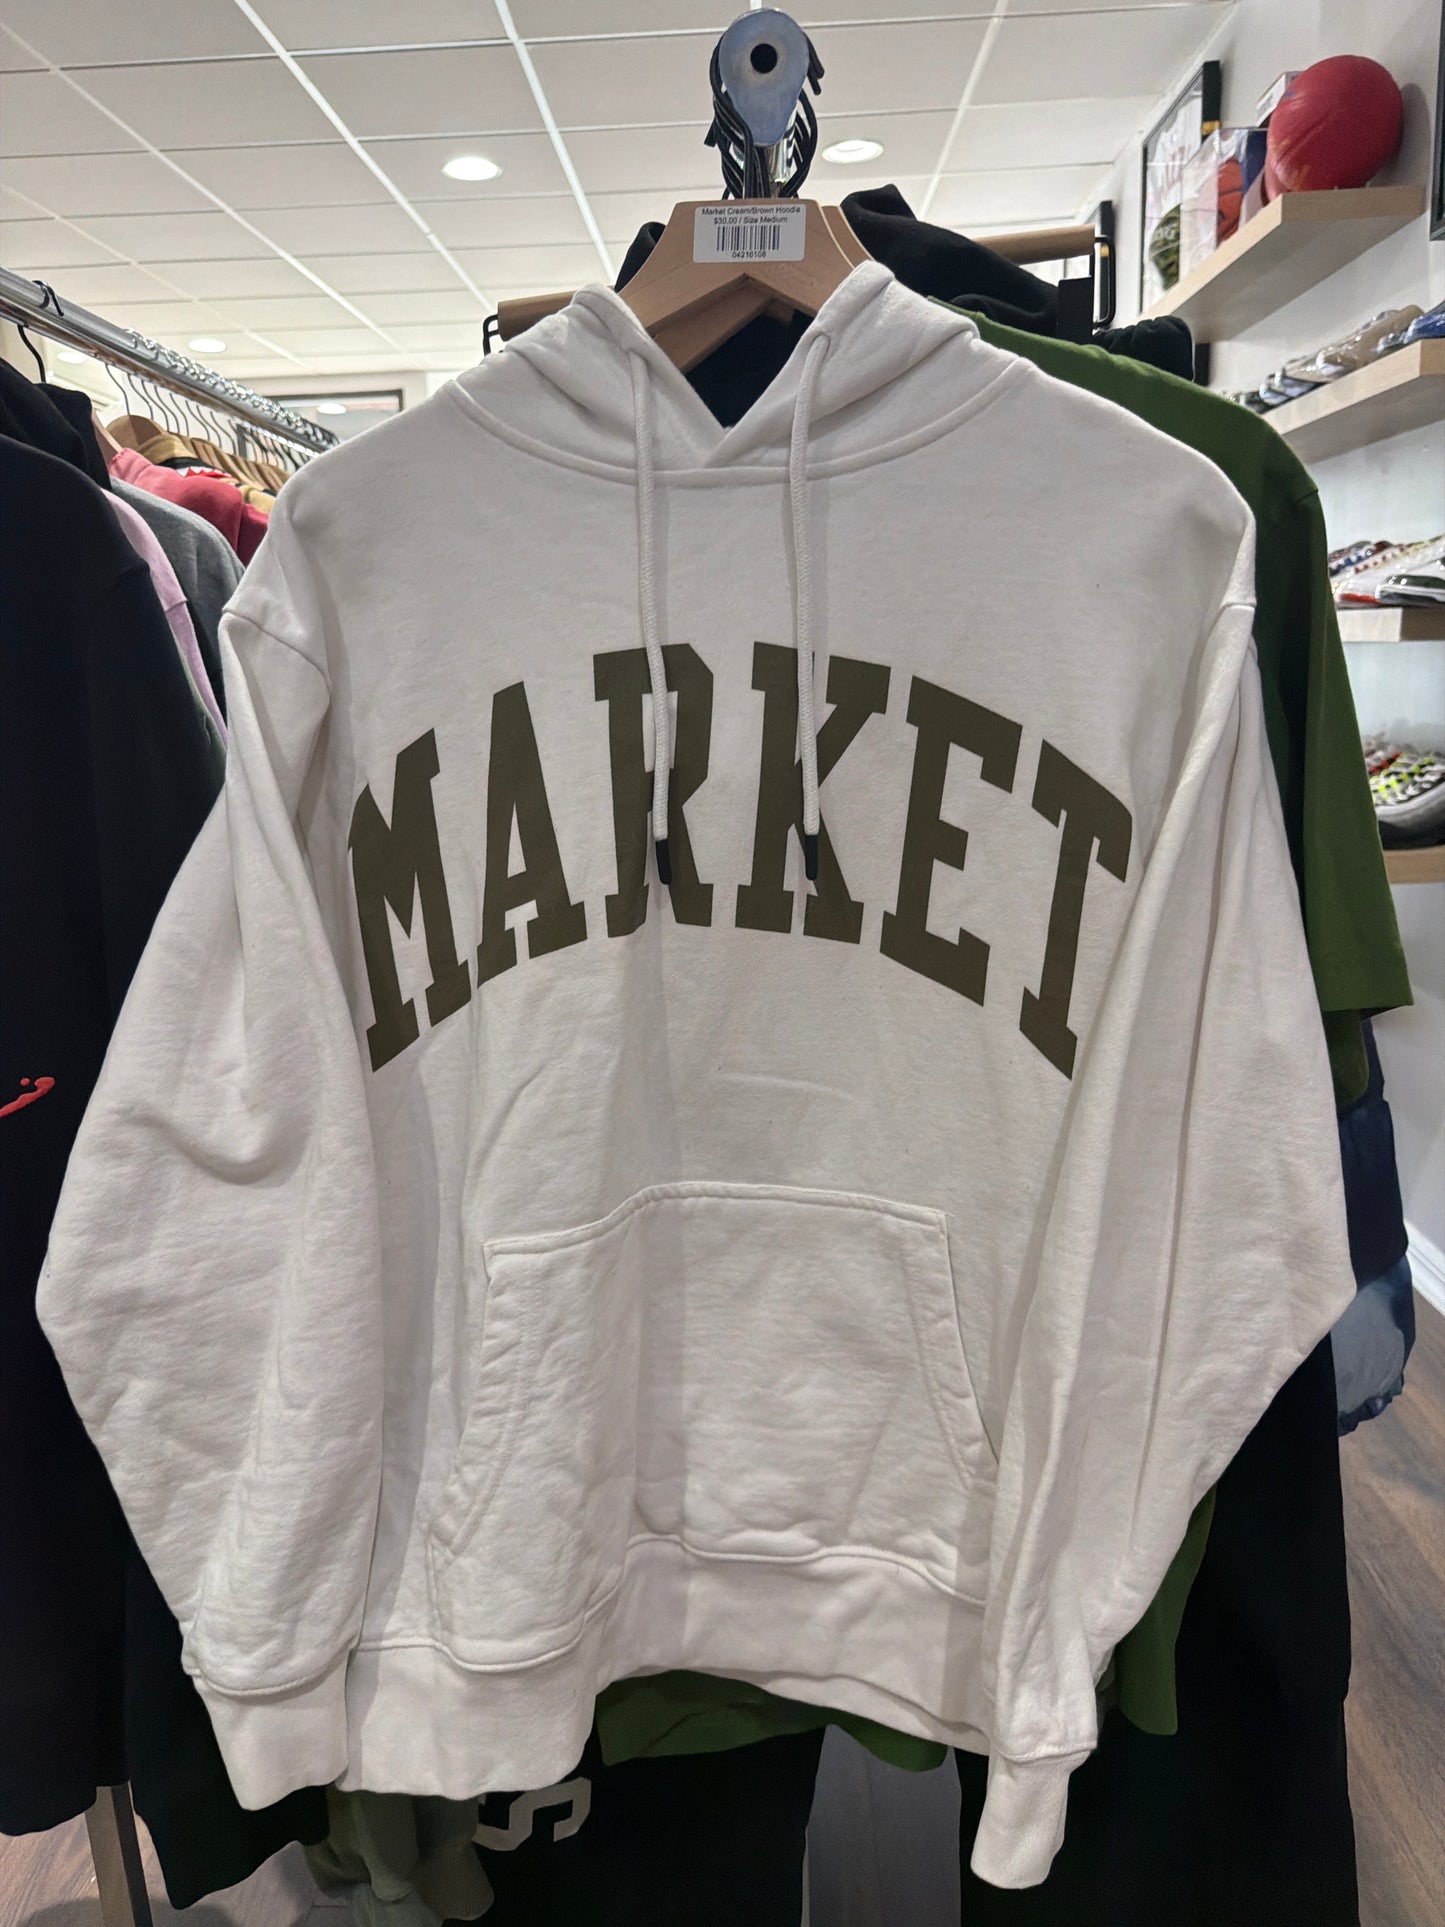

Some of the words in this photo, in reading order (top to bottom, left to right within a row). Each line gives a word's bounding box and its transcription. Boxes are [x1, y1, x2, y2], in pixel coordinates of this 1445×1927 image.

[701, 207, 726, 216] Market
[727, 206, 774, 215] Cream/Brown
[775, 205, 801, 214] Hoodie
[714, 216, 738, 225] $30.00
[743, 216, 759, 225] Size
[760, 215, 788, 224] Medium
[348, 641, 1133, 1081] MARKET
